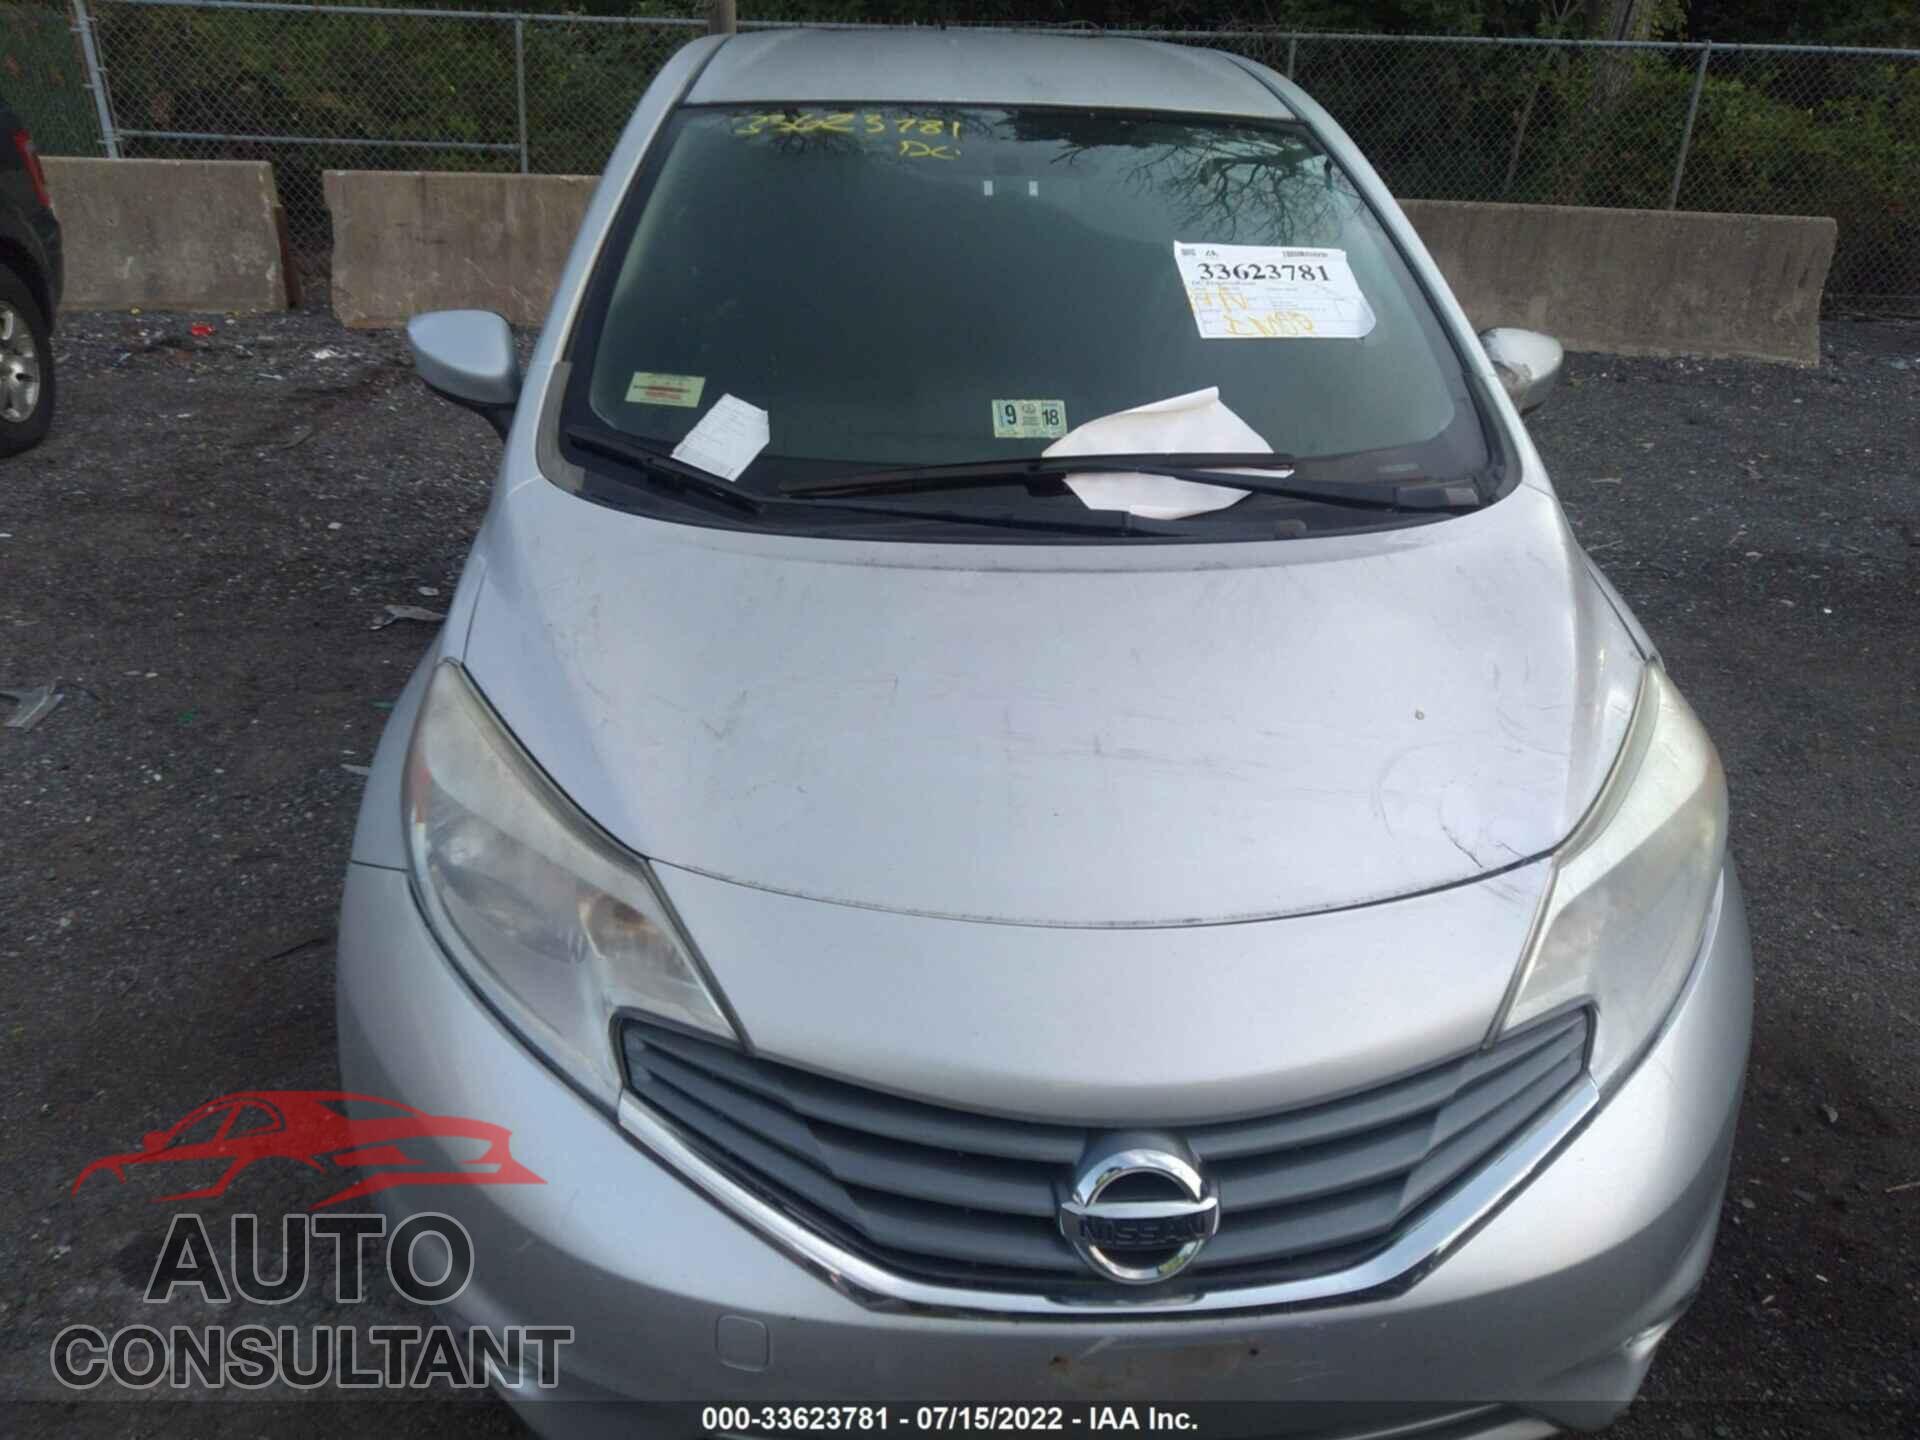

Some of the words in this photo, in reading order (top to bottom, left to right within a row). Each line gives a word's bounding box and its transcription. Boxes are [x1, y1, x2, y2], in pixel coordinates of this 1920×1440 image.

[1197, 262, 1331, 282] 33623781
[1004, 404, 1017, 425] 9
[1042, 408, 1060, 426] 18
[1079, 1217, 1206, 1247] NISSAN
